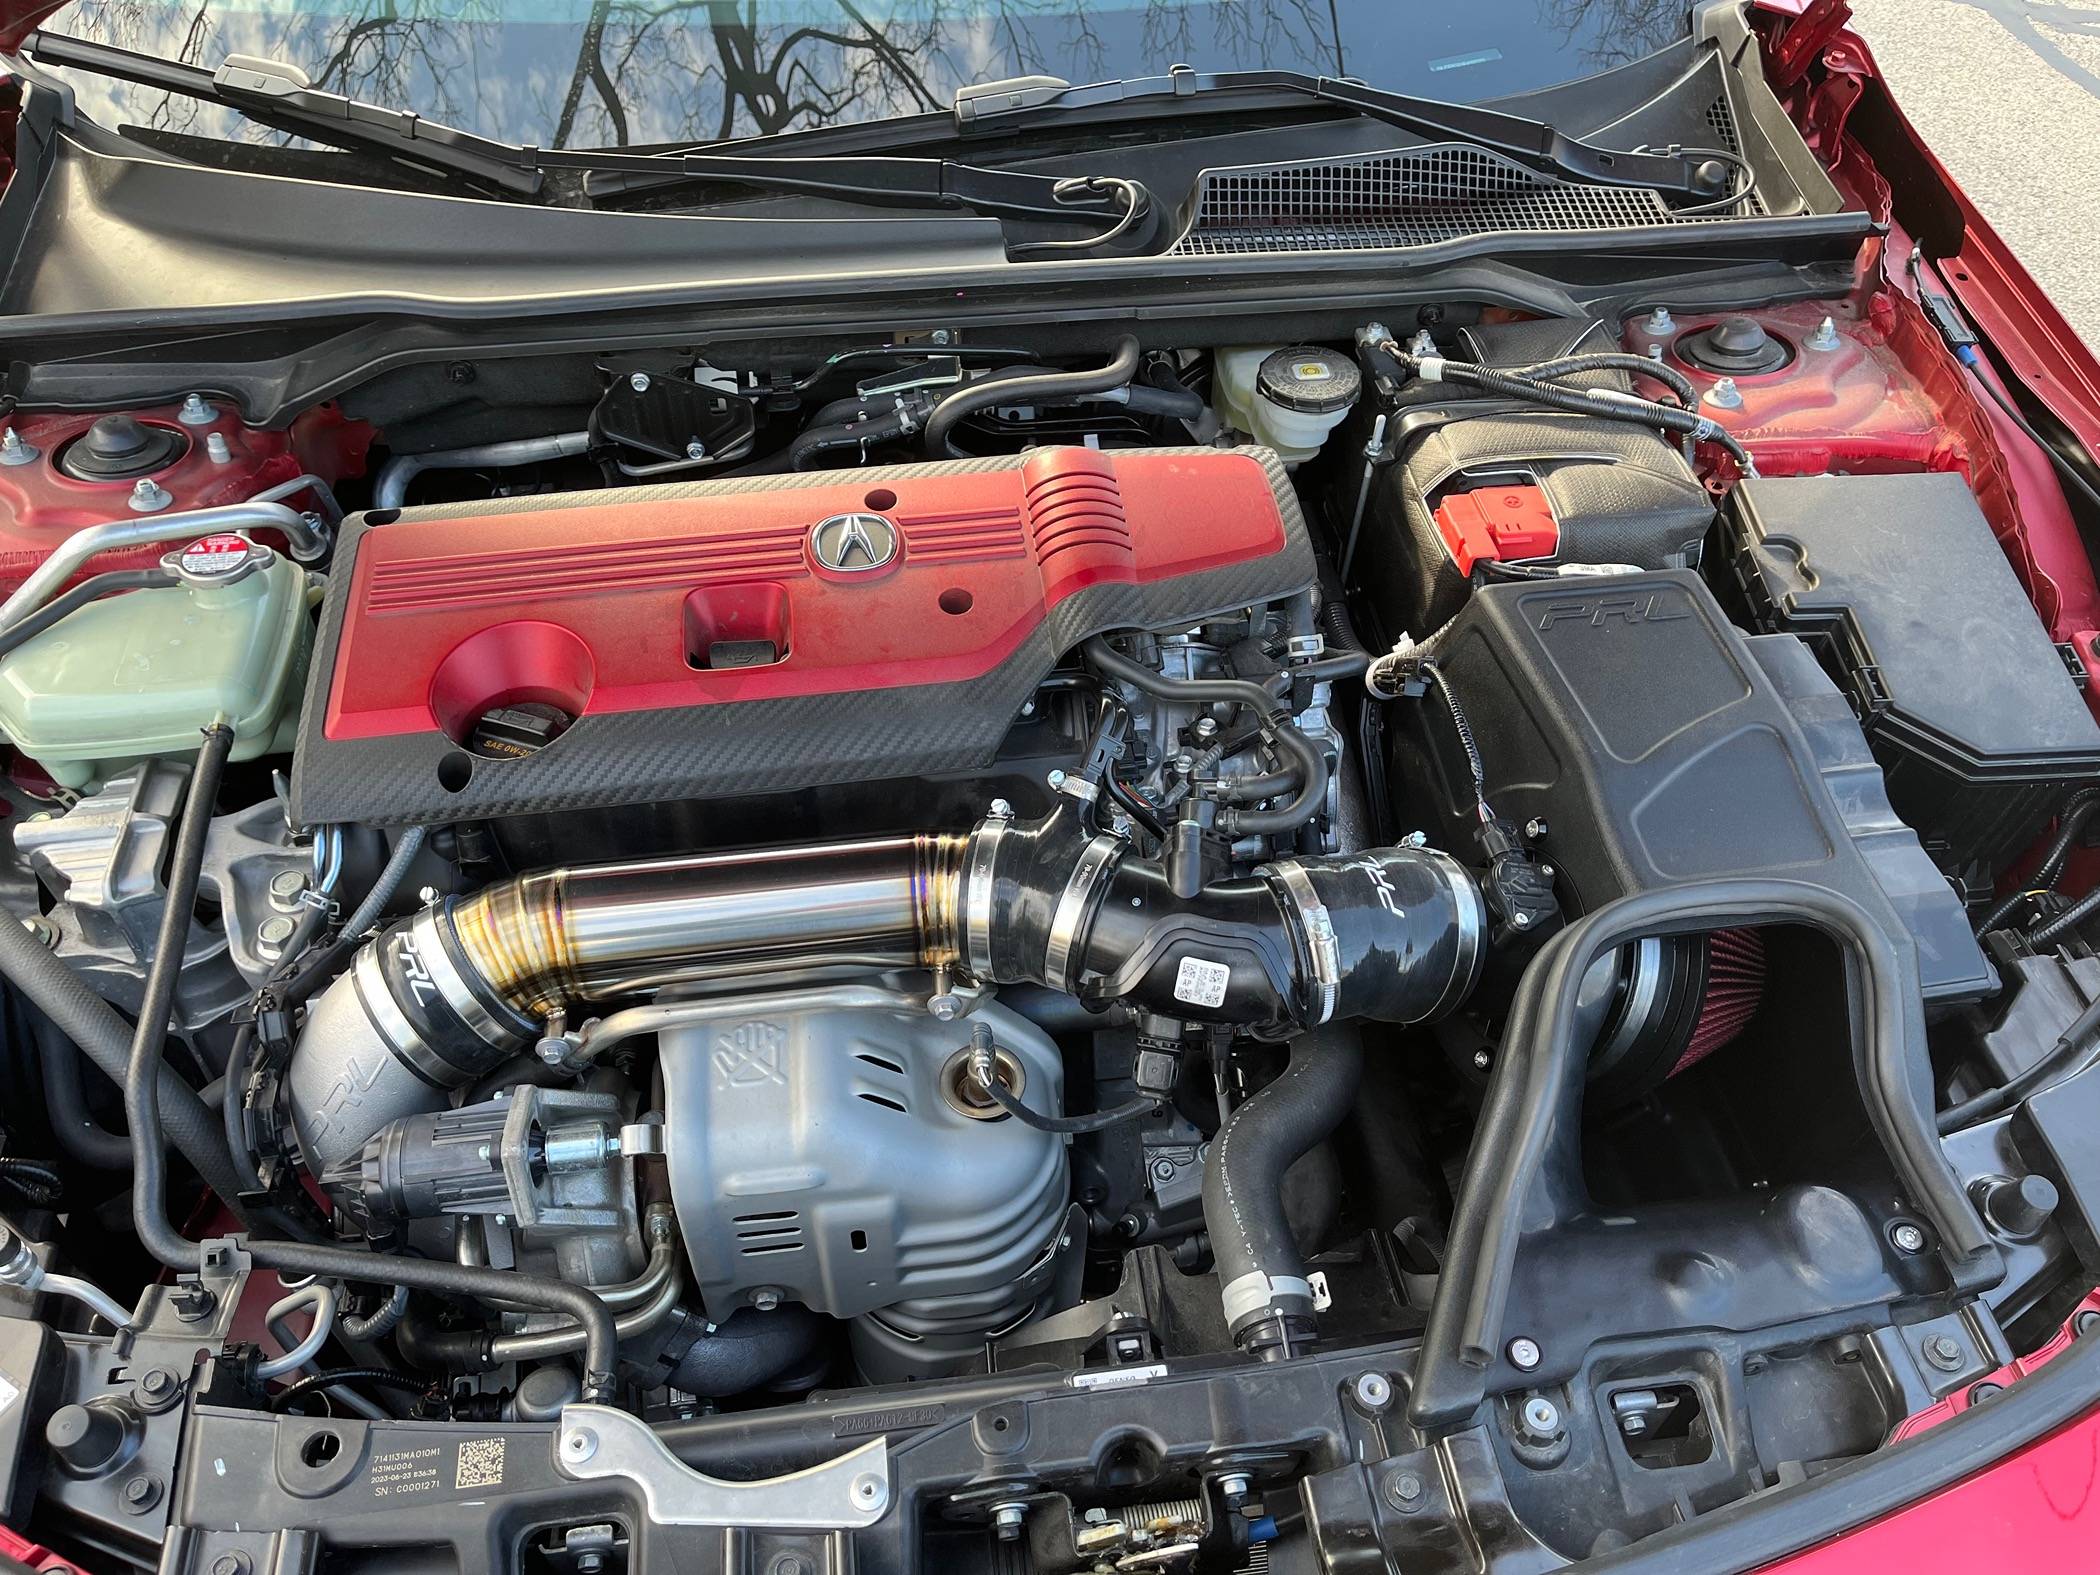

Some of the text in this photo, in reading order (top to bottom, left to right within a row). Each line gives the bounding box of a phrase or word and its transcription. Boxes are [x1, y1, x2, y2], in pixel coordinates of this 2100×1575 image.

[1538, 594, 1691, 631] PRL
[483, 739, 505, 751] SAE
[395, 931, 436, 1008] PRL
